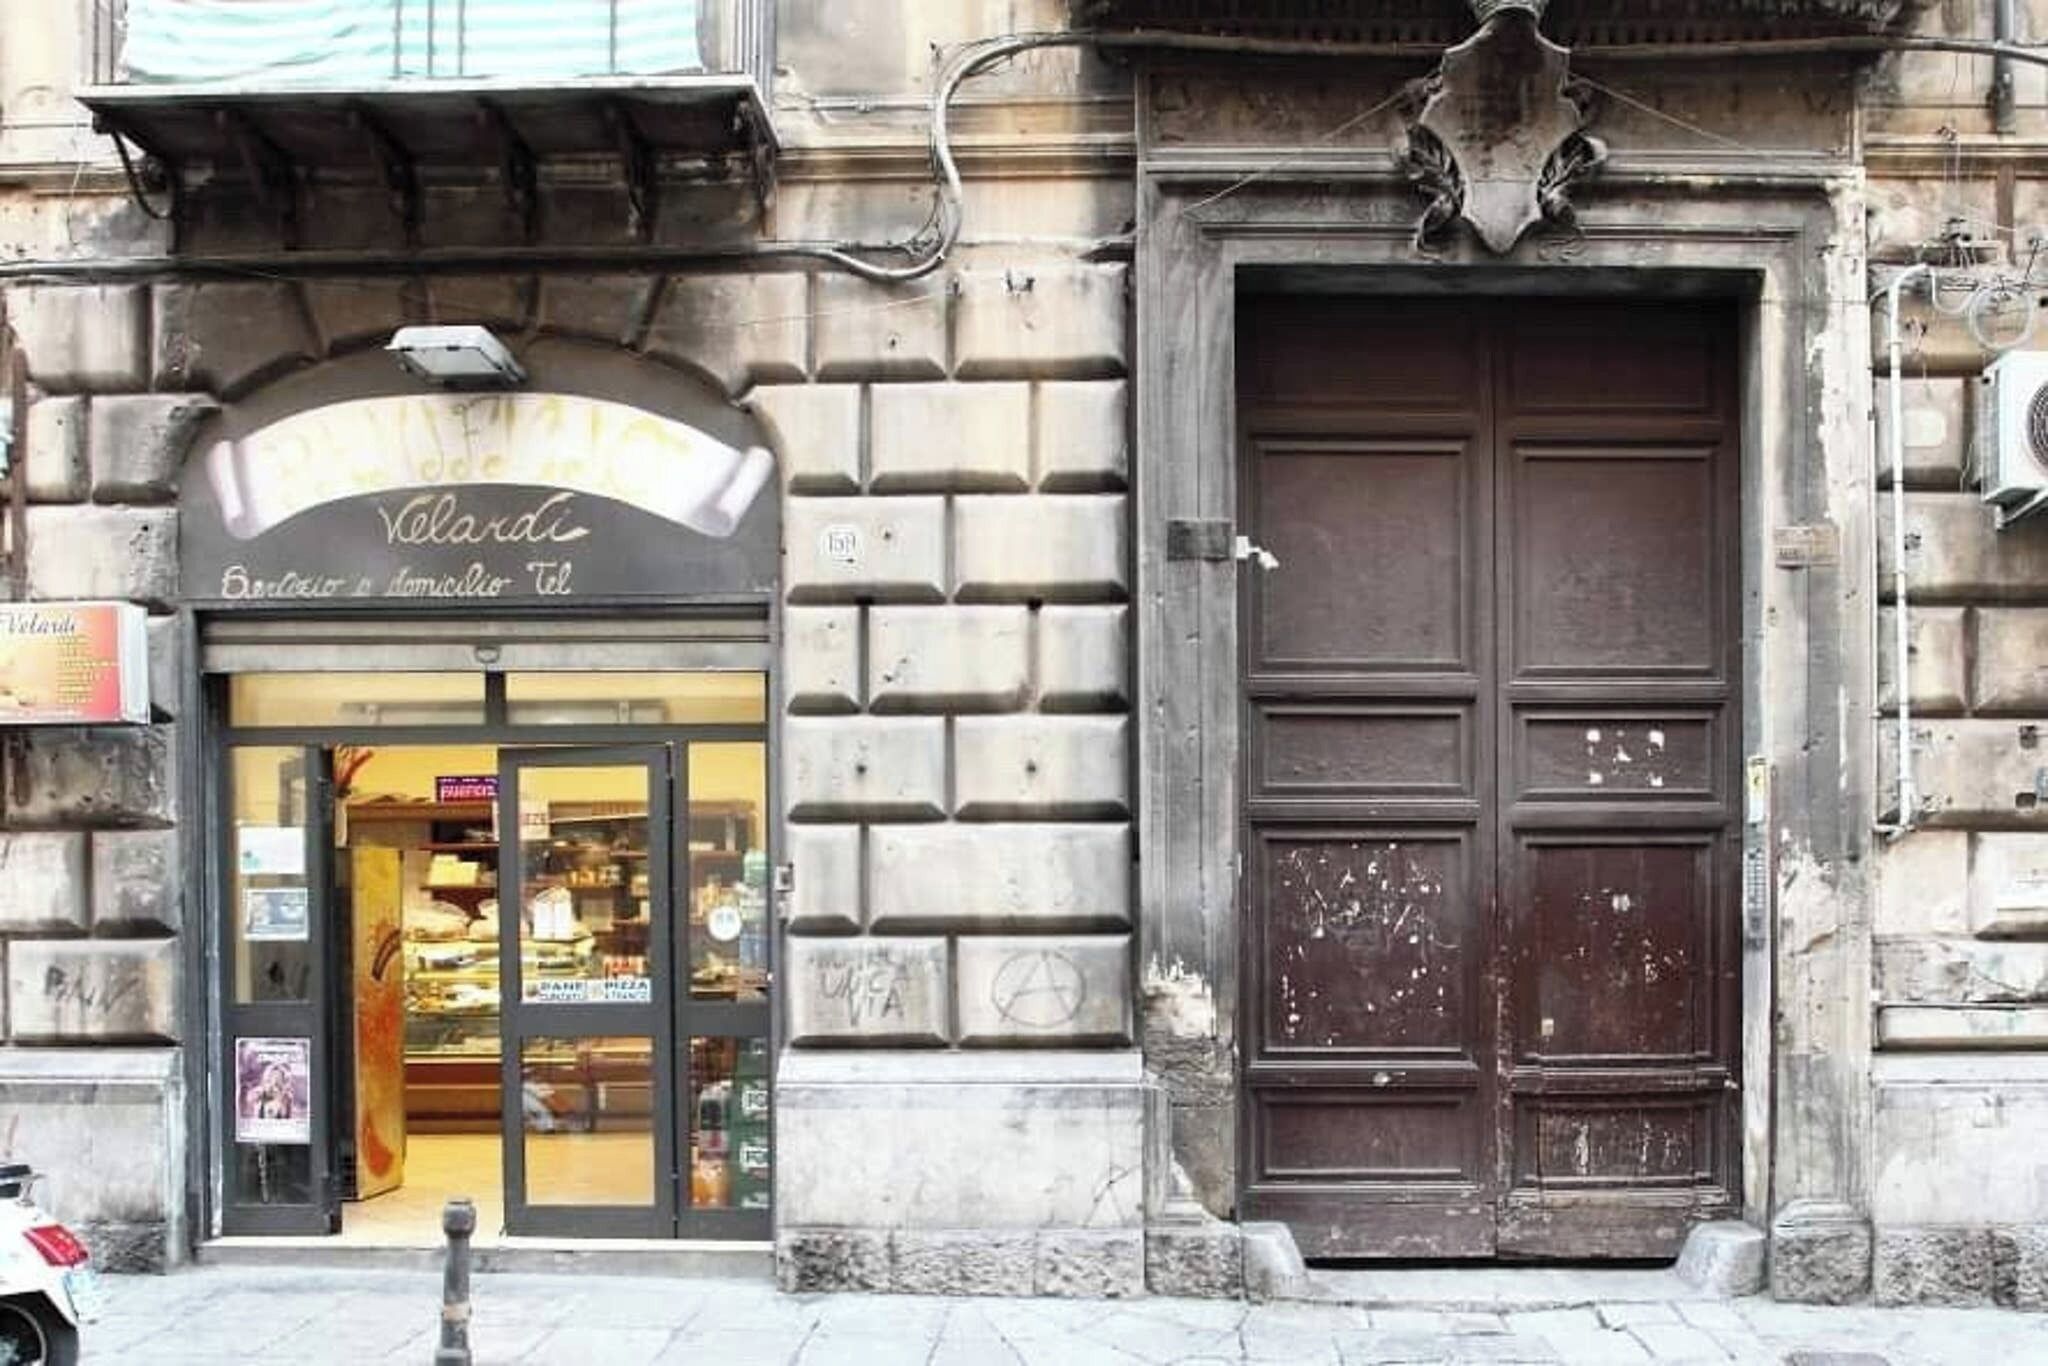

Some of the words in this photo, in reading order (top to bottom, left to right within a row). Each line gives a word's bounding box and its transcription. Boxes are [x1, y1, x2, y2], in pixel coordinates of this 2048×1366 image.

[378, 493, 591, 545] Velardi
[385, 562, 511, 598] domicilio
[527, 560, 573, 595] Tel
[8, 612, 76, 635] Velardi
